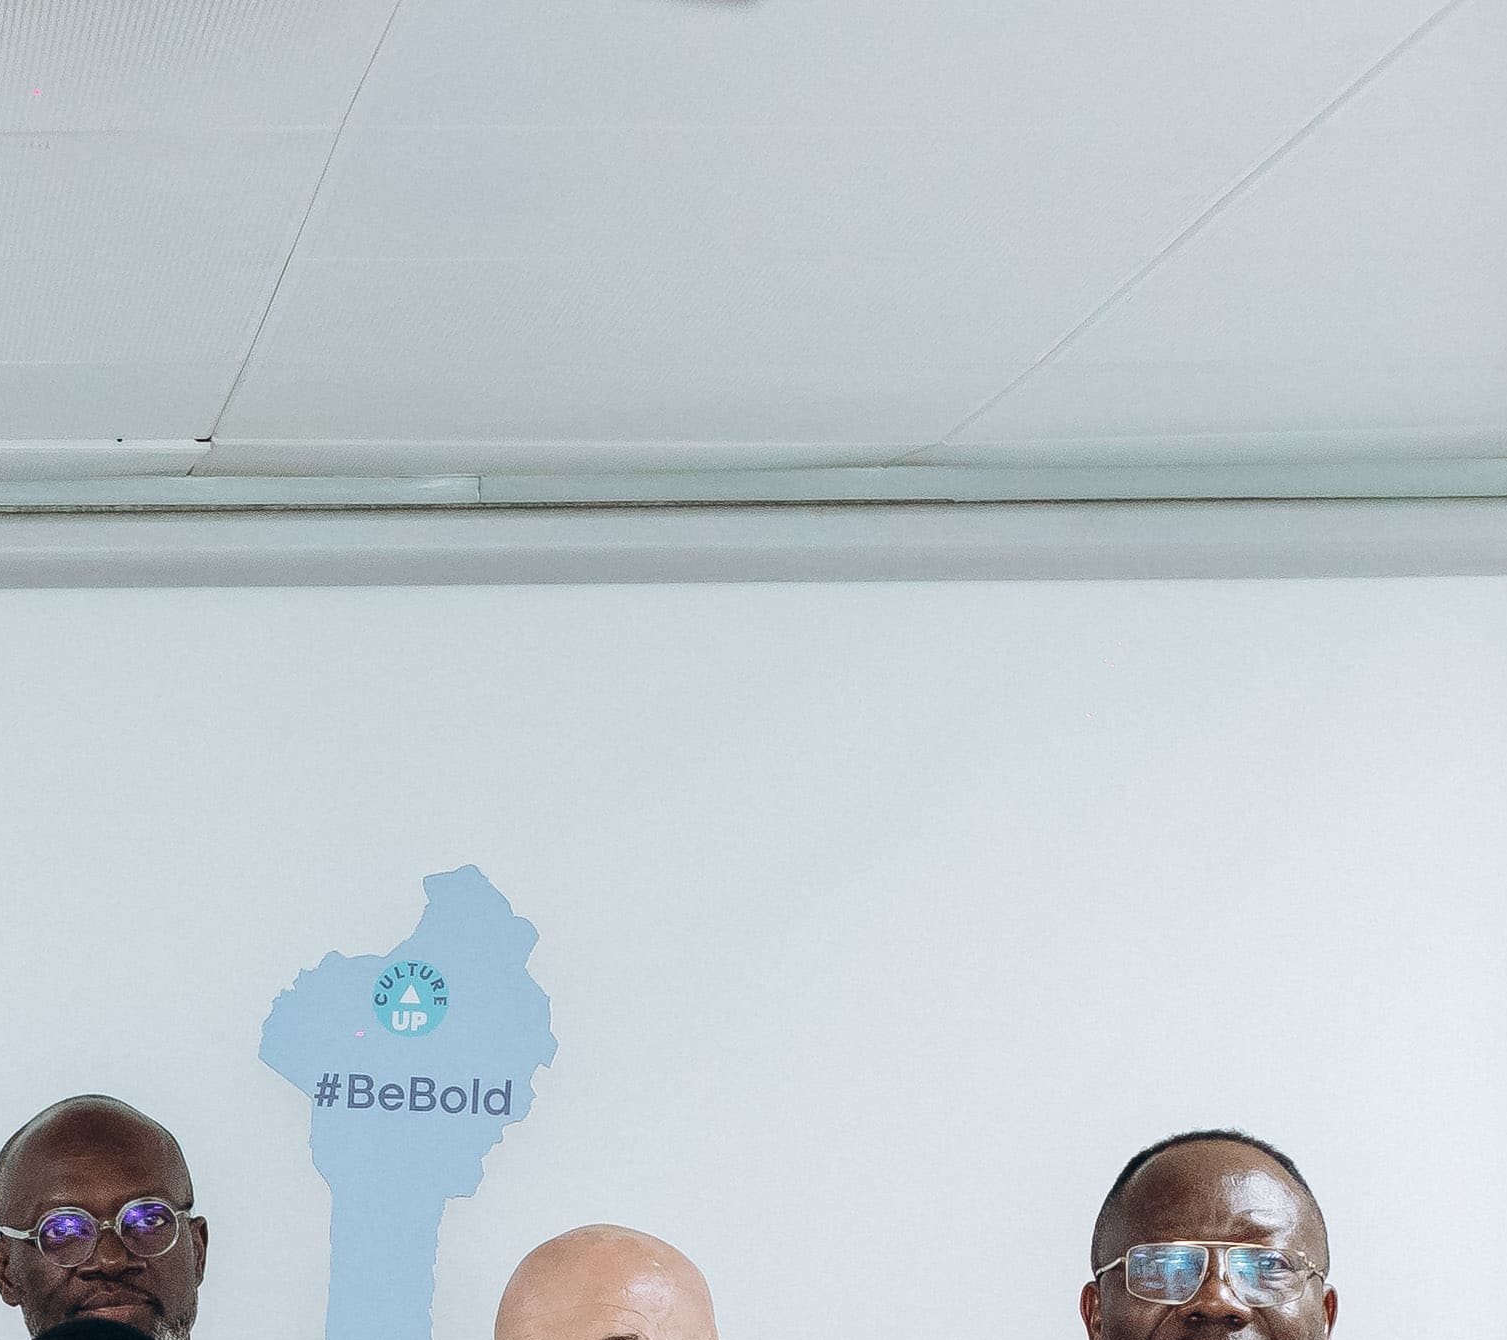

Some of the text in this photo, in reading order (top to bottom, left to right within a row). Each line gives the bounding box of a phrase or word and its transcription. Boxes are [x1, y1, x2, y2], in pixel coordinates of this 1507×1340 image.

[374, 963, 448, 1007] CULTURE
[391, 1010, 427, 1032] UP
[314, 1072, 512, 1116] #BeBold
